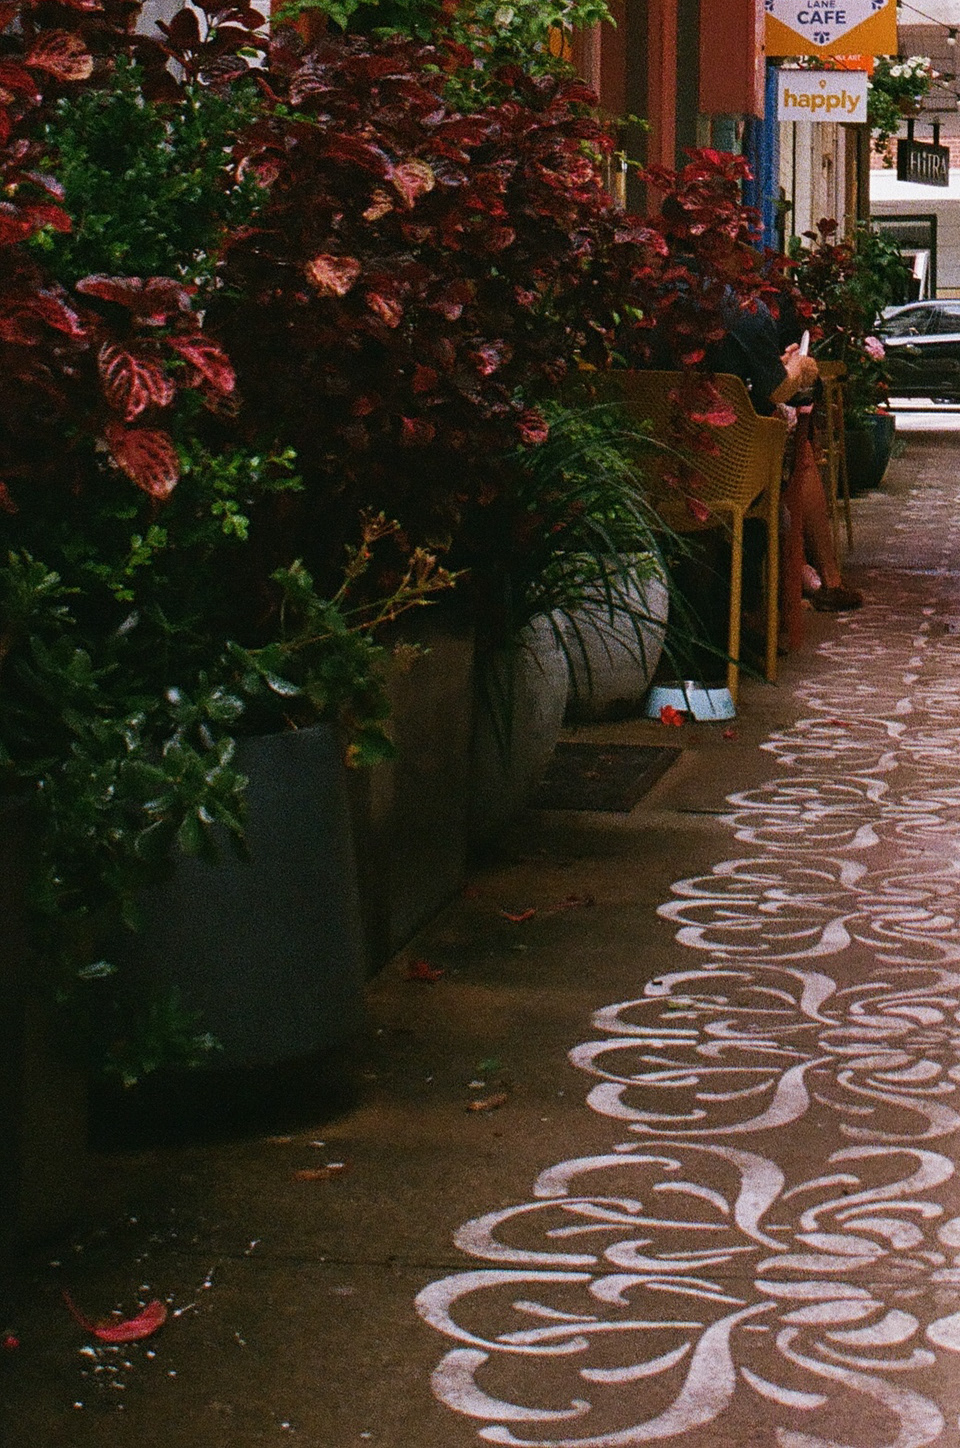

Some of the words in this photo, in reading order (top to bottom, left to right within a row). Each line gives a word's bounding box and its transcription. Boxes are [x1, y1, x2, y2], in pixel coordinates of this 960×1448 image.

[807, 0, 837, 9] LANE
[797, 10, 847, 25] CAFE
[783, 88, 861, 114] happly
